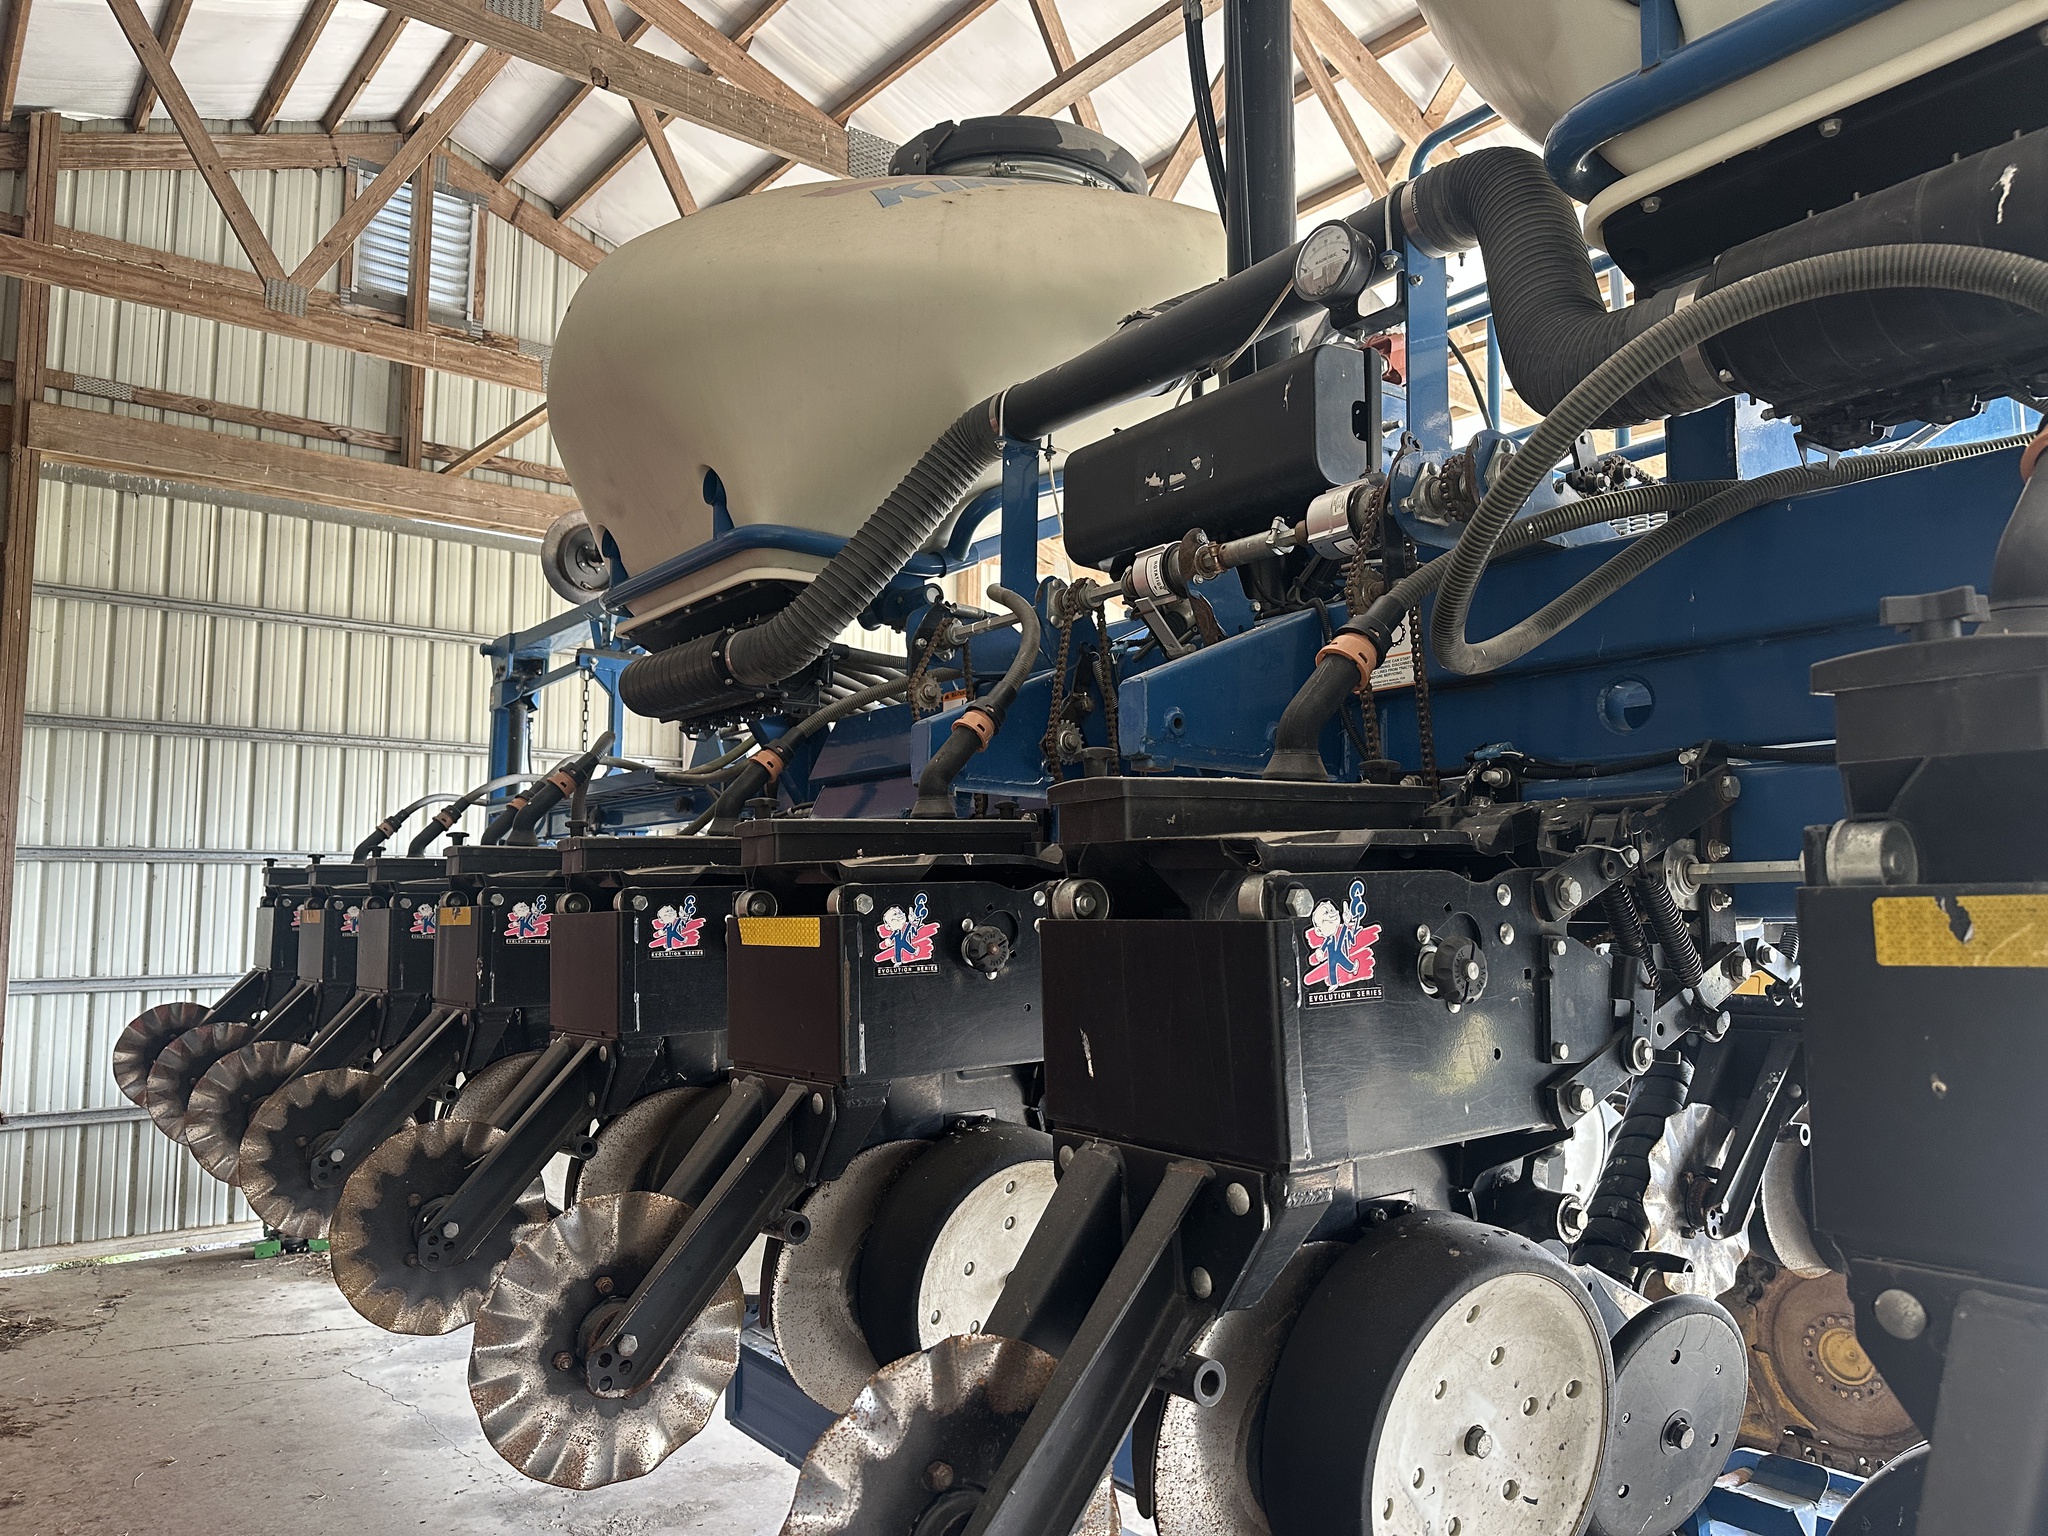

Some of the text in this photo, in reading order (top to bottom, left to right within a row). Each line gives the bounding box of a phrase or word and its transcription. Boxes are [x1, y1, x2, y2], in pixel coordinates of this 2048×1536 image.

[1153, 560, 1166, 590] ROTATION
[877, 964, 939, 975] EVOLUTION SERIES
[1309, 988, 1382, 1003] EVOLUTION SERIES
